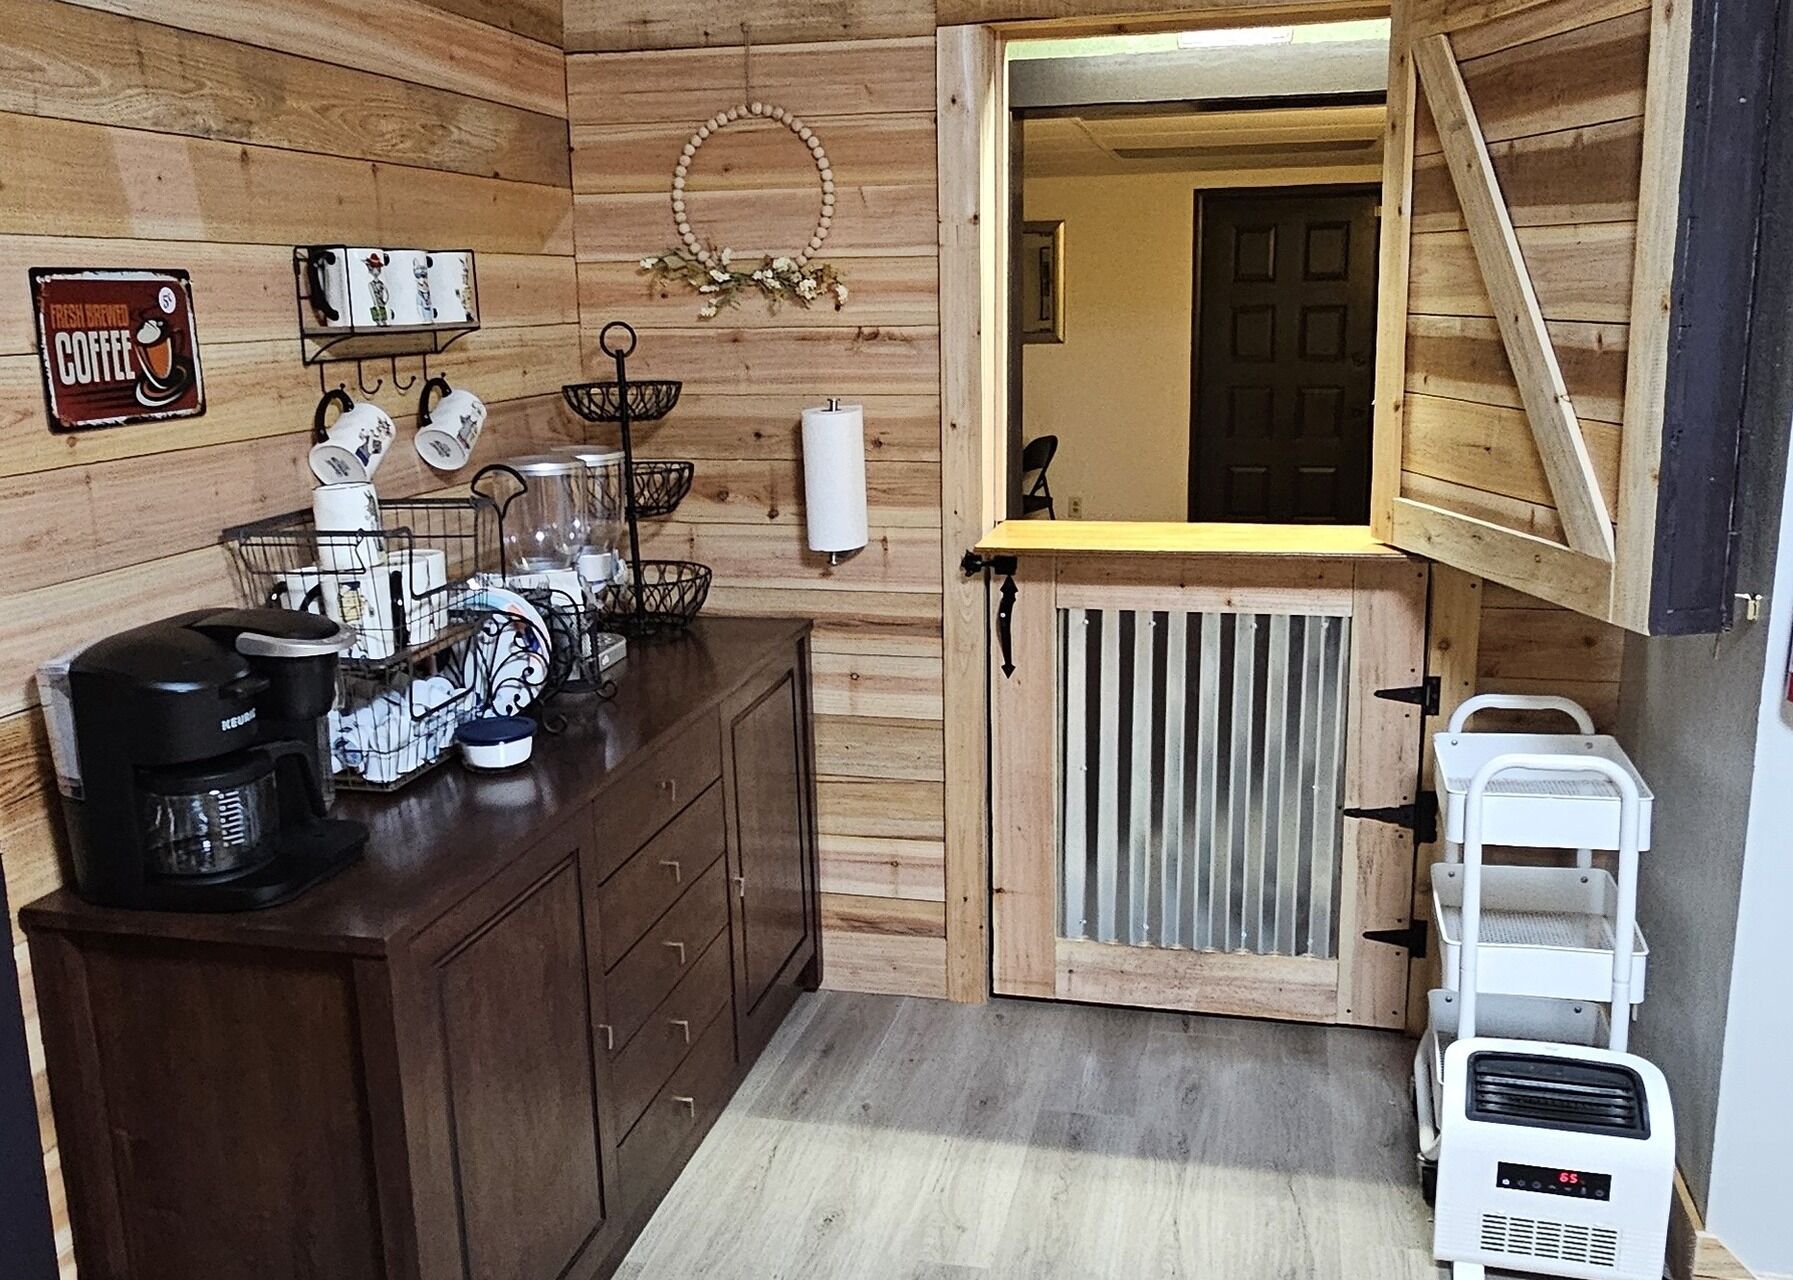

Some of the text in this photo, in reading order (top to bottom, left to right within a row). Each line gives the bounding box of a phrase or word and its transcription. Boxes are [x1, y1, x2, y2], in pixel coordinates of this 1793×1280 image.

[51, 303, 130, 329] FRESH BREWED
[55, 330, 136, 385] COFFEE
[1559, 1172, 1578, 1184] 65
